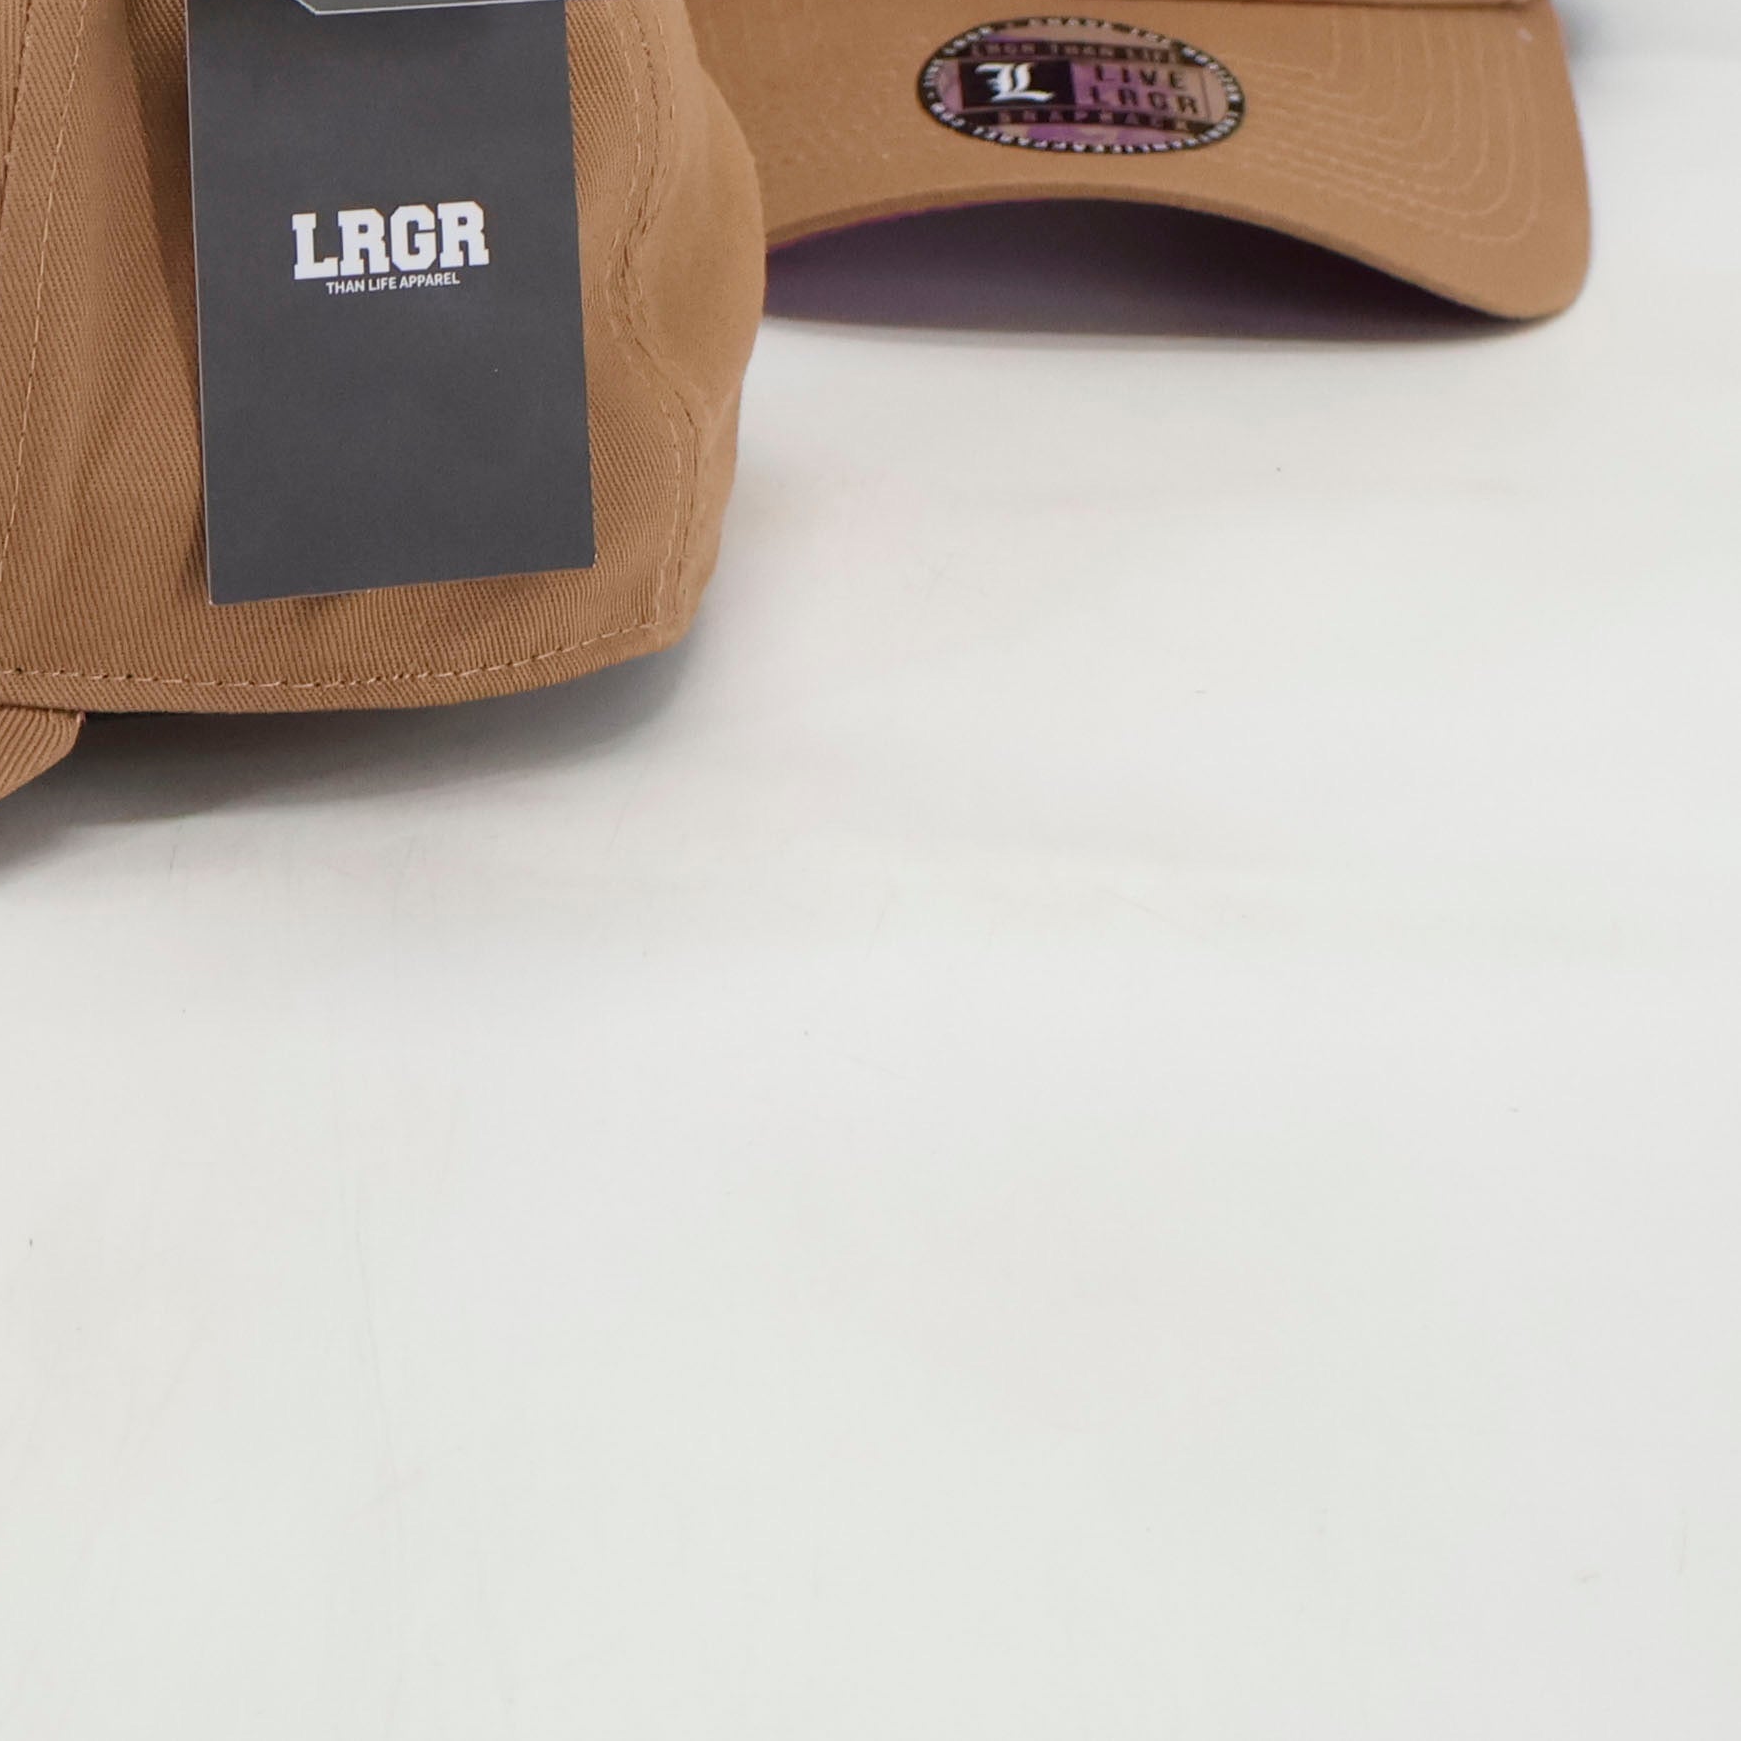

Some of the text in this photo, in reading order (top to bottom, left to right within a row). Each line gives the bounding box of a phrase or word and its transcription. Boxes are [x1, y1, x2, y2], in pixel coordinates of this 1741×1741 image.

[975, 62, 1055, 103] L
[292, 201, 489, 280] LRGR
[326, 272, 461, 295] THAN LIFE APPAREL
